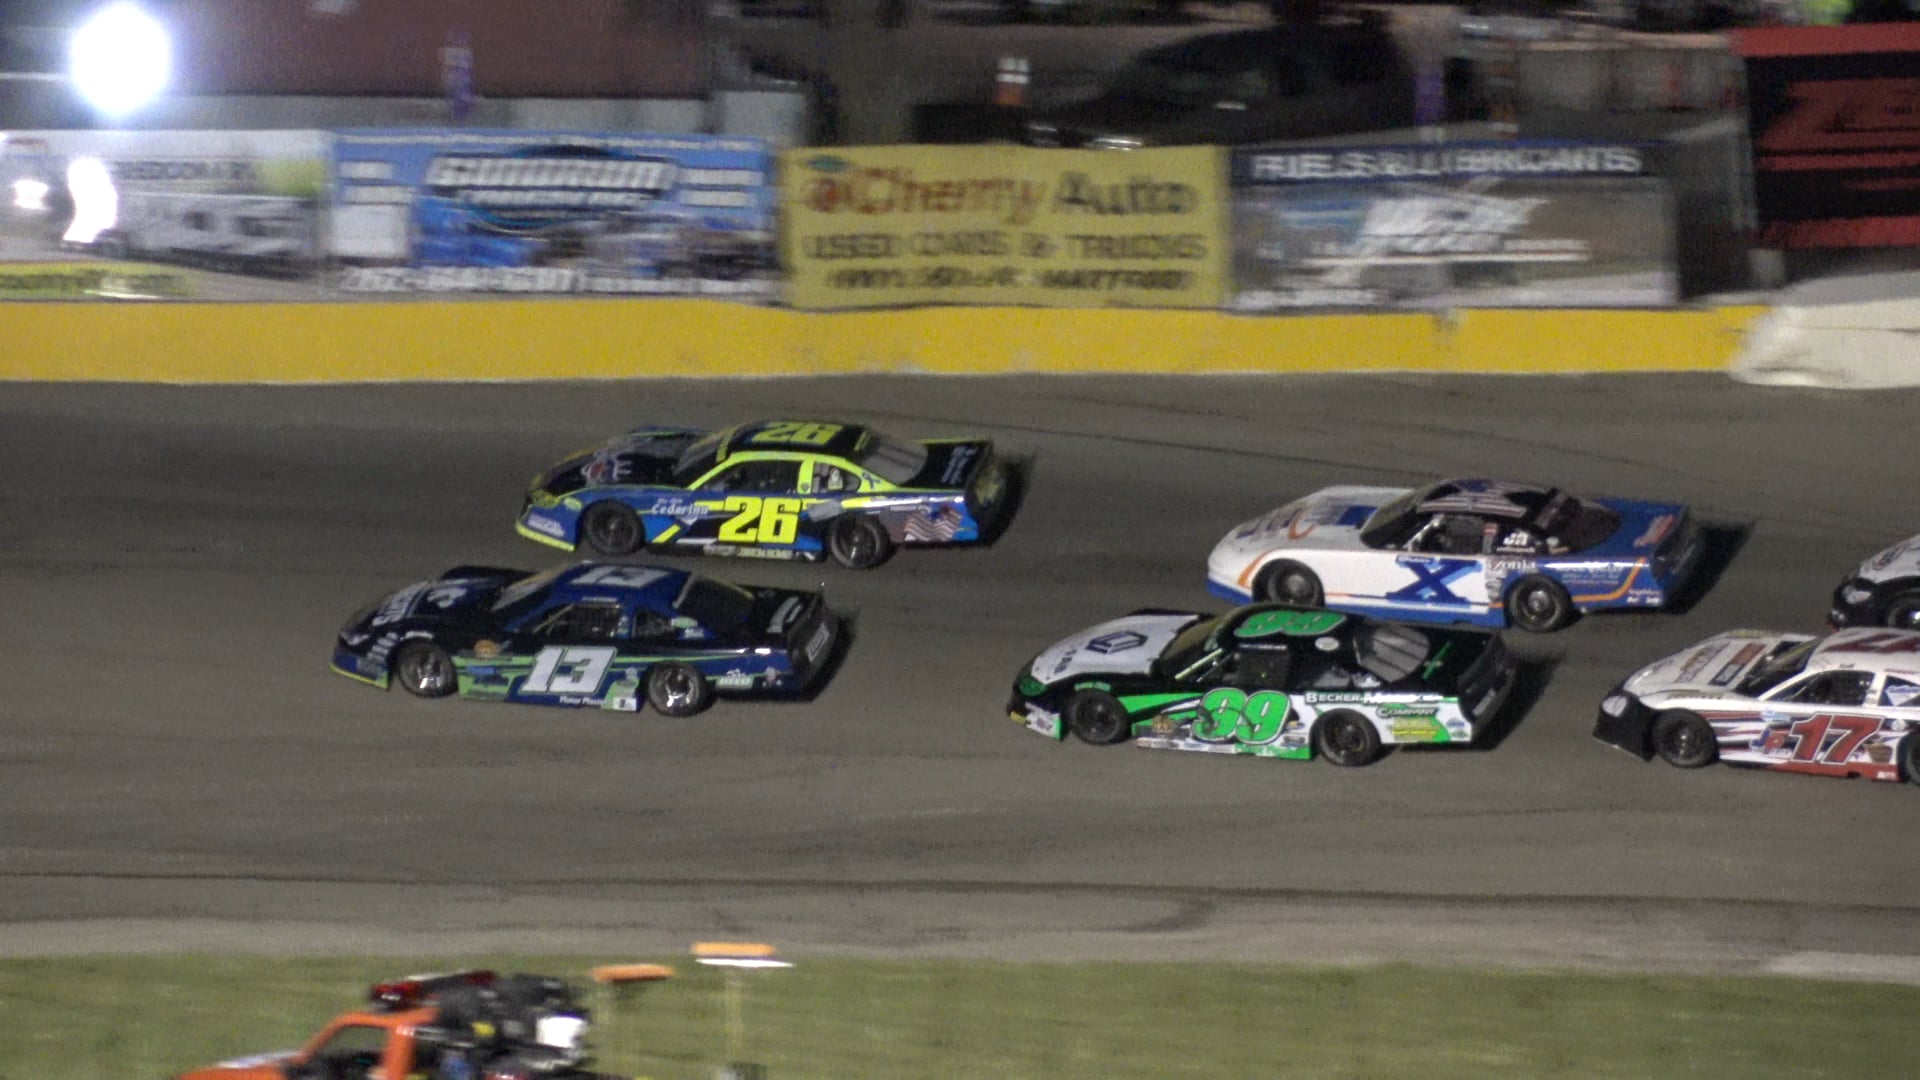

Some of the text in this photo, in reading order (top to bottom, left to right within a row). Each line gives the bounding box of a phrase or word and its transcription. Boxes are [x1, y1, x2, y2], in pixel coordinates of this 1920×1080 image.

[855, 168, 1199, 224] Cherry Auto
[751, 421, 844, 445] 26
[718, 496, 802, 543] 26
[518, 645, 617, 694] 13
[1191, 687, 1290, 745] 99
[1789, 712, 1886, 765] 17
